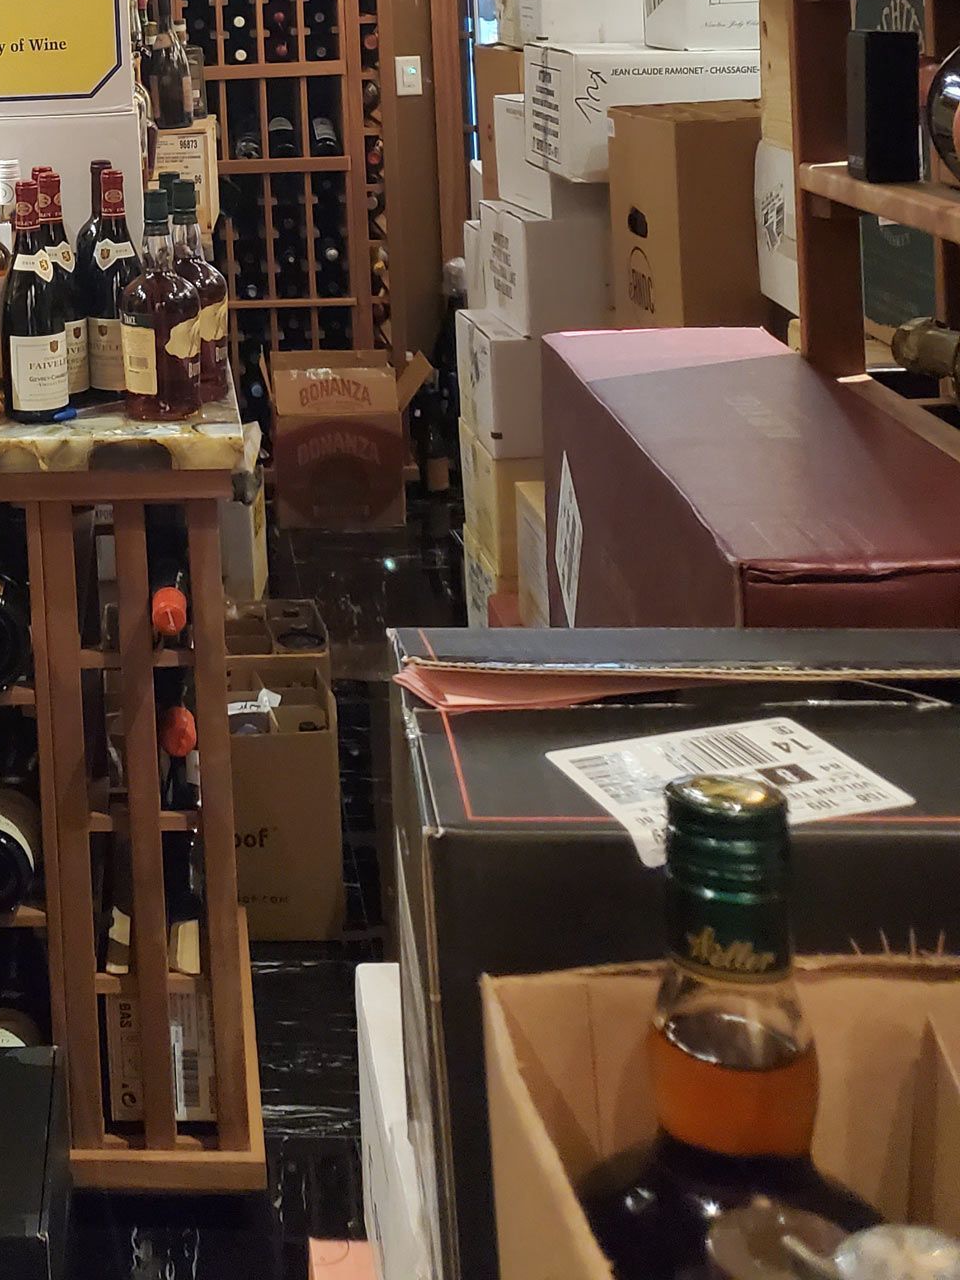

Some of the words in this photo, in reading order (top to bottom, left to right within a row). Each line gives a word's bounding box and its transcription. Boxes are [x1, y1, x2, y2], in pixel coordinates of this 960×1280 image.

[10, 37, 25, 53] of
[28, 37, 68, 52] Wine
[610, 67, 631, 77] JEAN
[632, 66, 664, 76] CLAUDE
[664, 66, 704, 76] RAMONET
[298, 377, 373, 408] BONANZA
